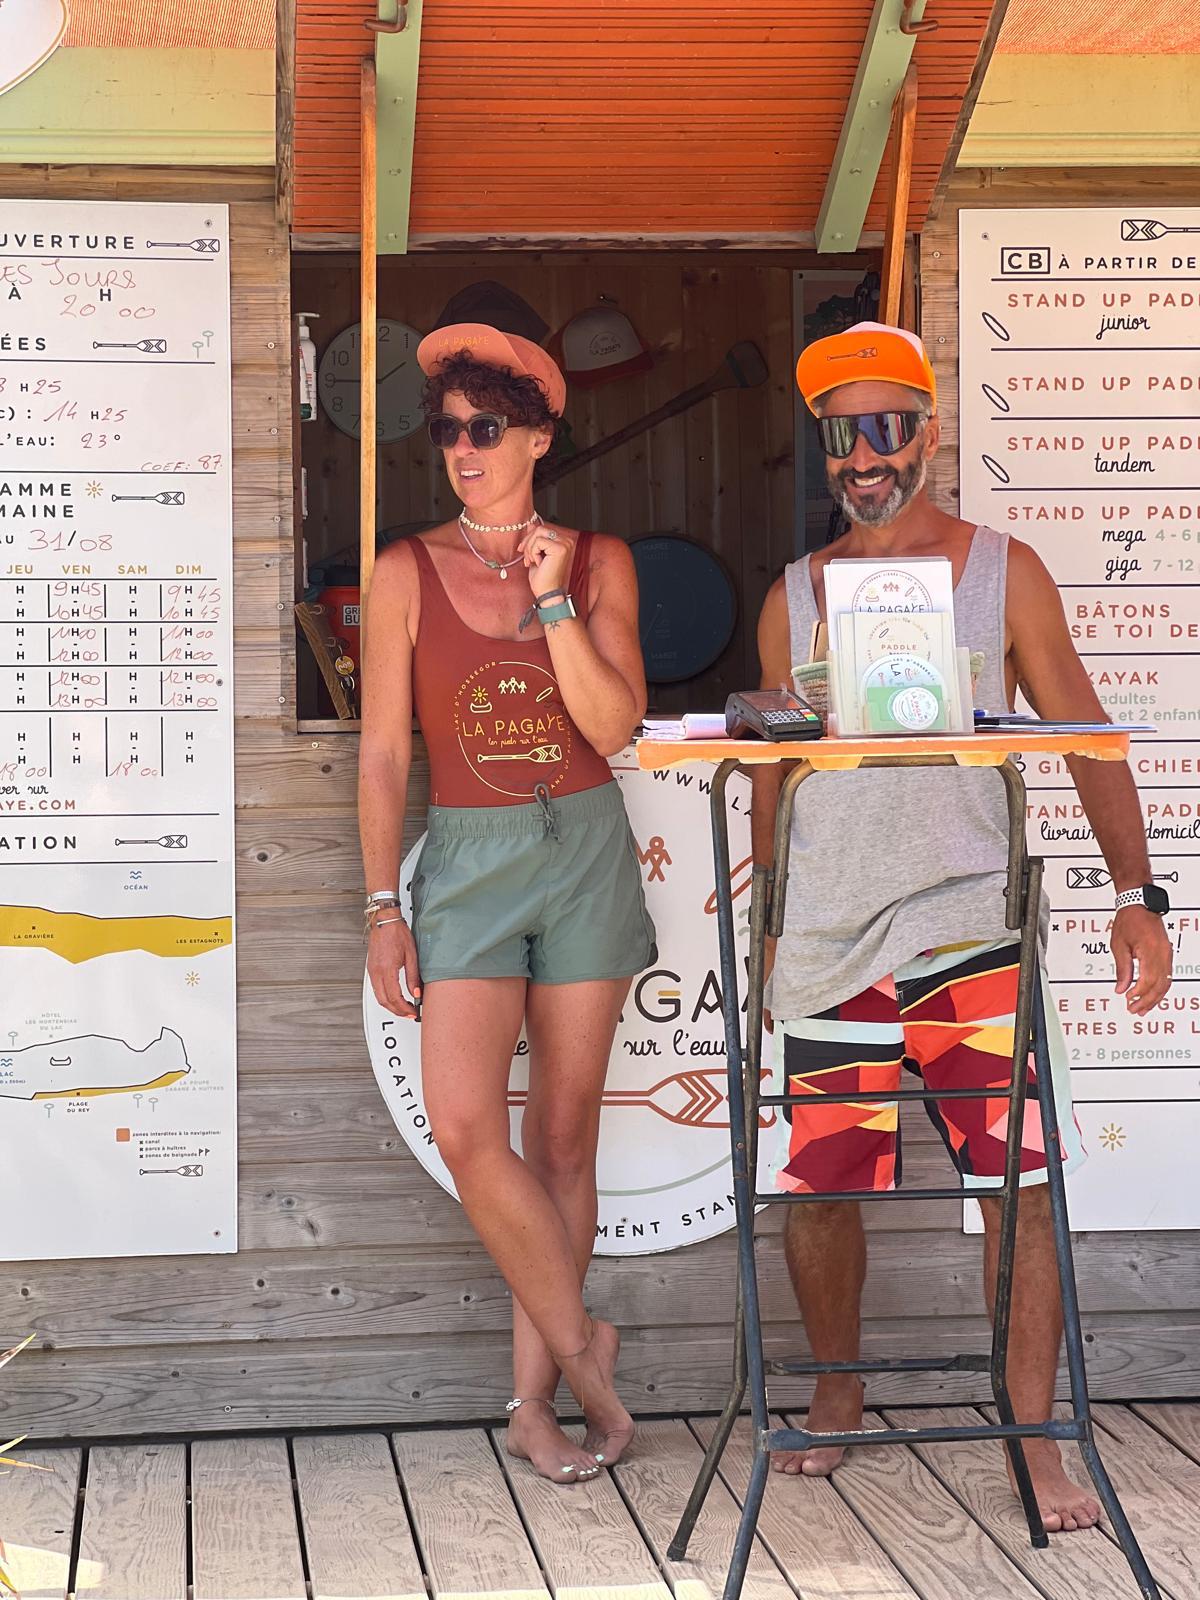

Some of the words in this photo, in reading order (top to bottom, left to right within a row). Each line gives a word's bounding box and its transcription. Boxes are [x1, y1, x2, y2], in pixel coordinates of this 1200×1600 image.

[1007, 252, 1043, 270] CB
[1058, 254, 1070, 269] À
[1084, 256, 1158, 270] PARTIR
[1171, 256, 1197, 269] DE
[1007, 292, 1086, 308] STAND
[1102, 292, 1132, 308] UP
[1148, 292, 1200, 308] PAD
[1096, 314, 1151, 341] junior
[332, 350, 350, 366] 10
[1007, 376, 1085, 391] STAND
[1101, 376, 1131, 391] UP
[1147, 376, 1200, 391] PAD
[399, 414, 410, 430] 5
[1007, 436, 1085, 451] STAND
[1101, 436, 1131, 451] UP
[1147, 436, 1200, 451] PAD
[1094, 452, 1156, 473] tandem
[1007, 506, 1085, 521] STAND
[1101, 506, 1131, 520] UP
[1147, 506, 1200, 520] PAD
[1101, 529, 1147, 552] mega
[6, 564, 34, 575] JEU
[62, 564, 91, 575] VEN
[117, 564, 148, 575] SAM
[175, 564, 203, 575] DIM
[1105, 556, 1142, 581] giga
[1076, 600, 1171, 619] BÂTONS
[1114, 624, 1153, 639] TOI
[1170, 624, 1199, 638] DE
[463, 721, 485, 737] LA
[494, 713, 565, 736] PAGAYE
[1137, 759, 1200, 773] CHIE
[1147, 803, 1200, 818] PAD
[1066, 919, 1114, 933] PILA
[1081, 941, 1110, 955] sur
[1085, 998, 1110, 1012] ET
[1062, 1022, 1118, 1036] TRES
[1133, 1021, 1175, 1035] SUR
[623, 1039, 662, 1056] sur
[1071, 1048, 1081, 1060] 2
[1096, 1048, 1106, 1060] 8
[1111, 1047, 1192, 1062] personnes
[596, 1221, 661, 1238] MENT
[681, 1192, 737, 1227] STAN
